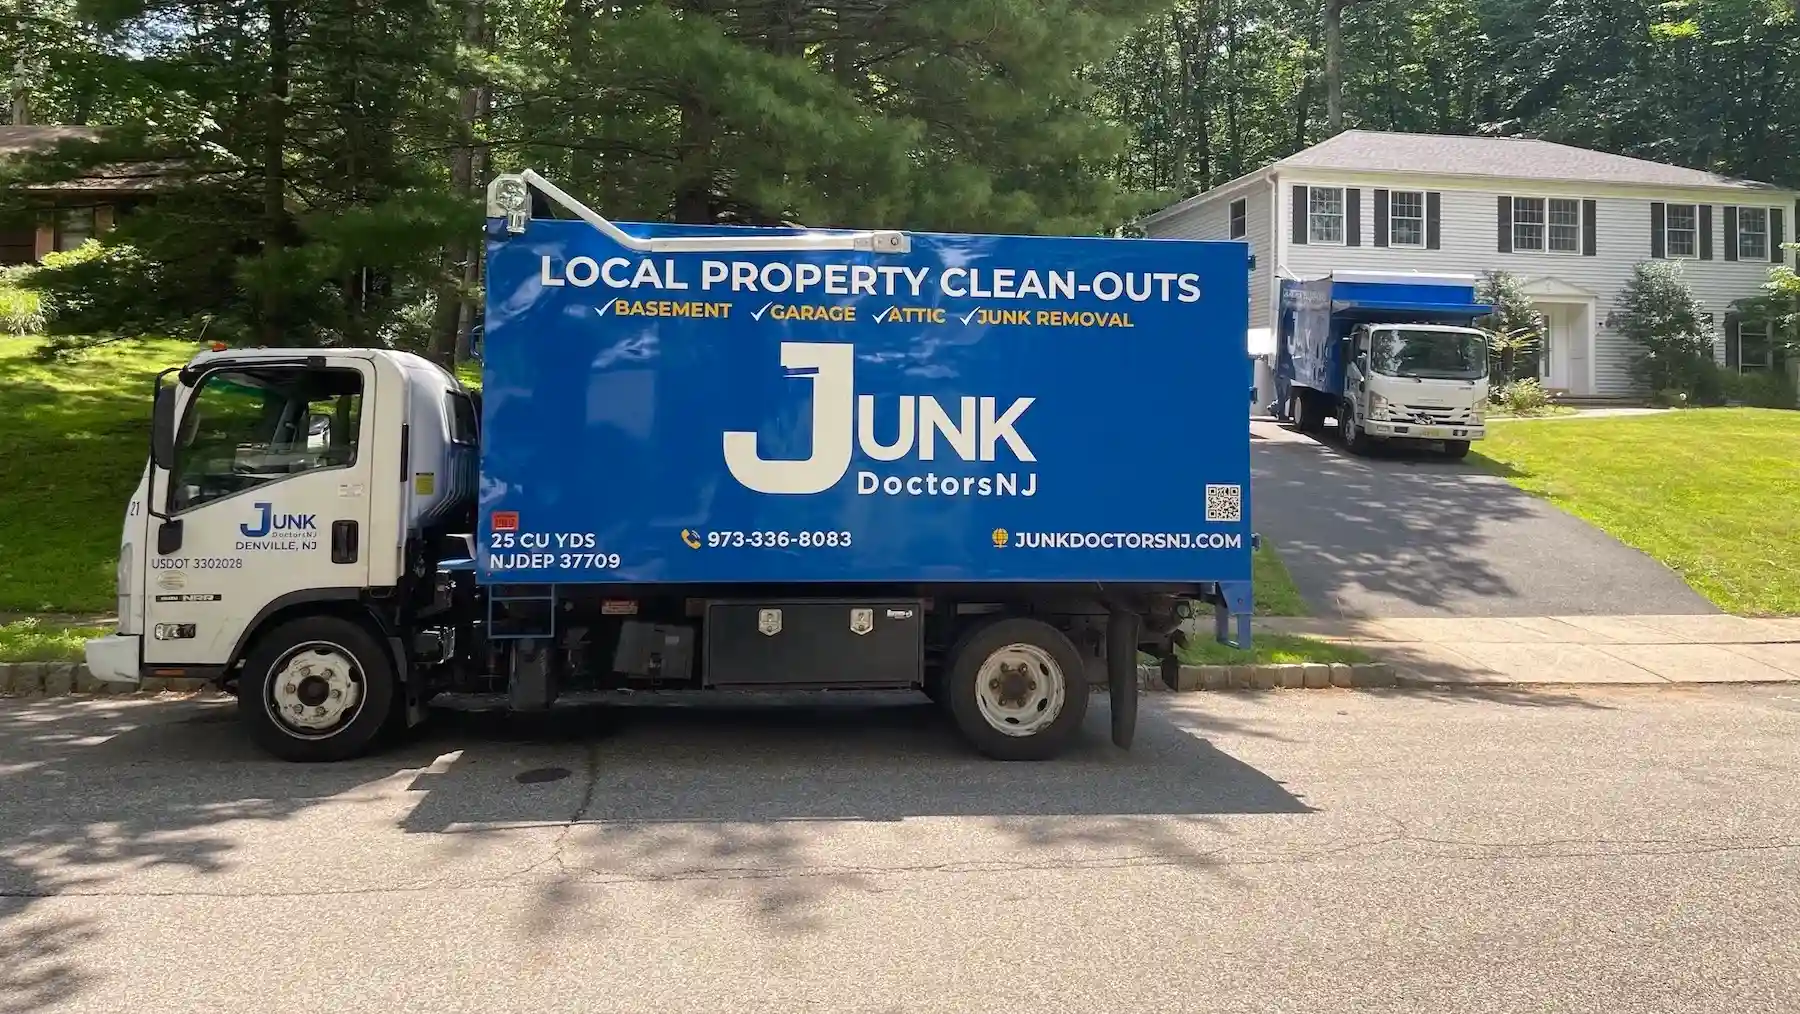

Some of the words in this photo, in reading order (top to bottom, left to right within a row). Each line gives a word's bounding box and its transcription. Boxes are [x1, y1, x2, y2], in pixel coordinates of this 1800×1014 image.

[541, 255, 688, 290] LOCAL
[702, 260, 929, 296] PROPERTY
[940, 267, 1200, 303] CLEAN-OUTS
[615, 300, 732, 318] BASEMENT
[770, 304, 857, 322] GARAGE
[888, 308, 945, 323] ATTIC
[977, 310, 1031, 325] JUNK
[1036, 311, 1134, 328] REMOVAL
[723, 342, 1037, 494] JUNK
[857, 471, 1037, 496] DoctorsNJ
[240, 503, 317, 537] JUNK
[236, 541, 298, 551] DENVILLE,
[302, 541, 317, 550] NJ
[490, 532, 514, 548] 25
[519, 532, 549, 548] CU
[554, 533, 596, 548] YDS
[707, 531, 852, 547] 973-336-8083
[1015, 532, 1241, 549] JUNKDOCTORSNJ.COM
[151, 558, 190, 569] USDOT
[193, 558, 243, 569] 3302028
[489, 553, 555, 569] NJDEP
[559, 553, 621, 569] 37709
